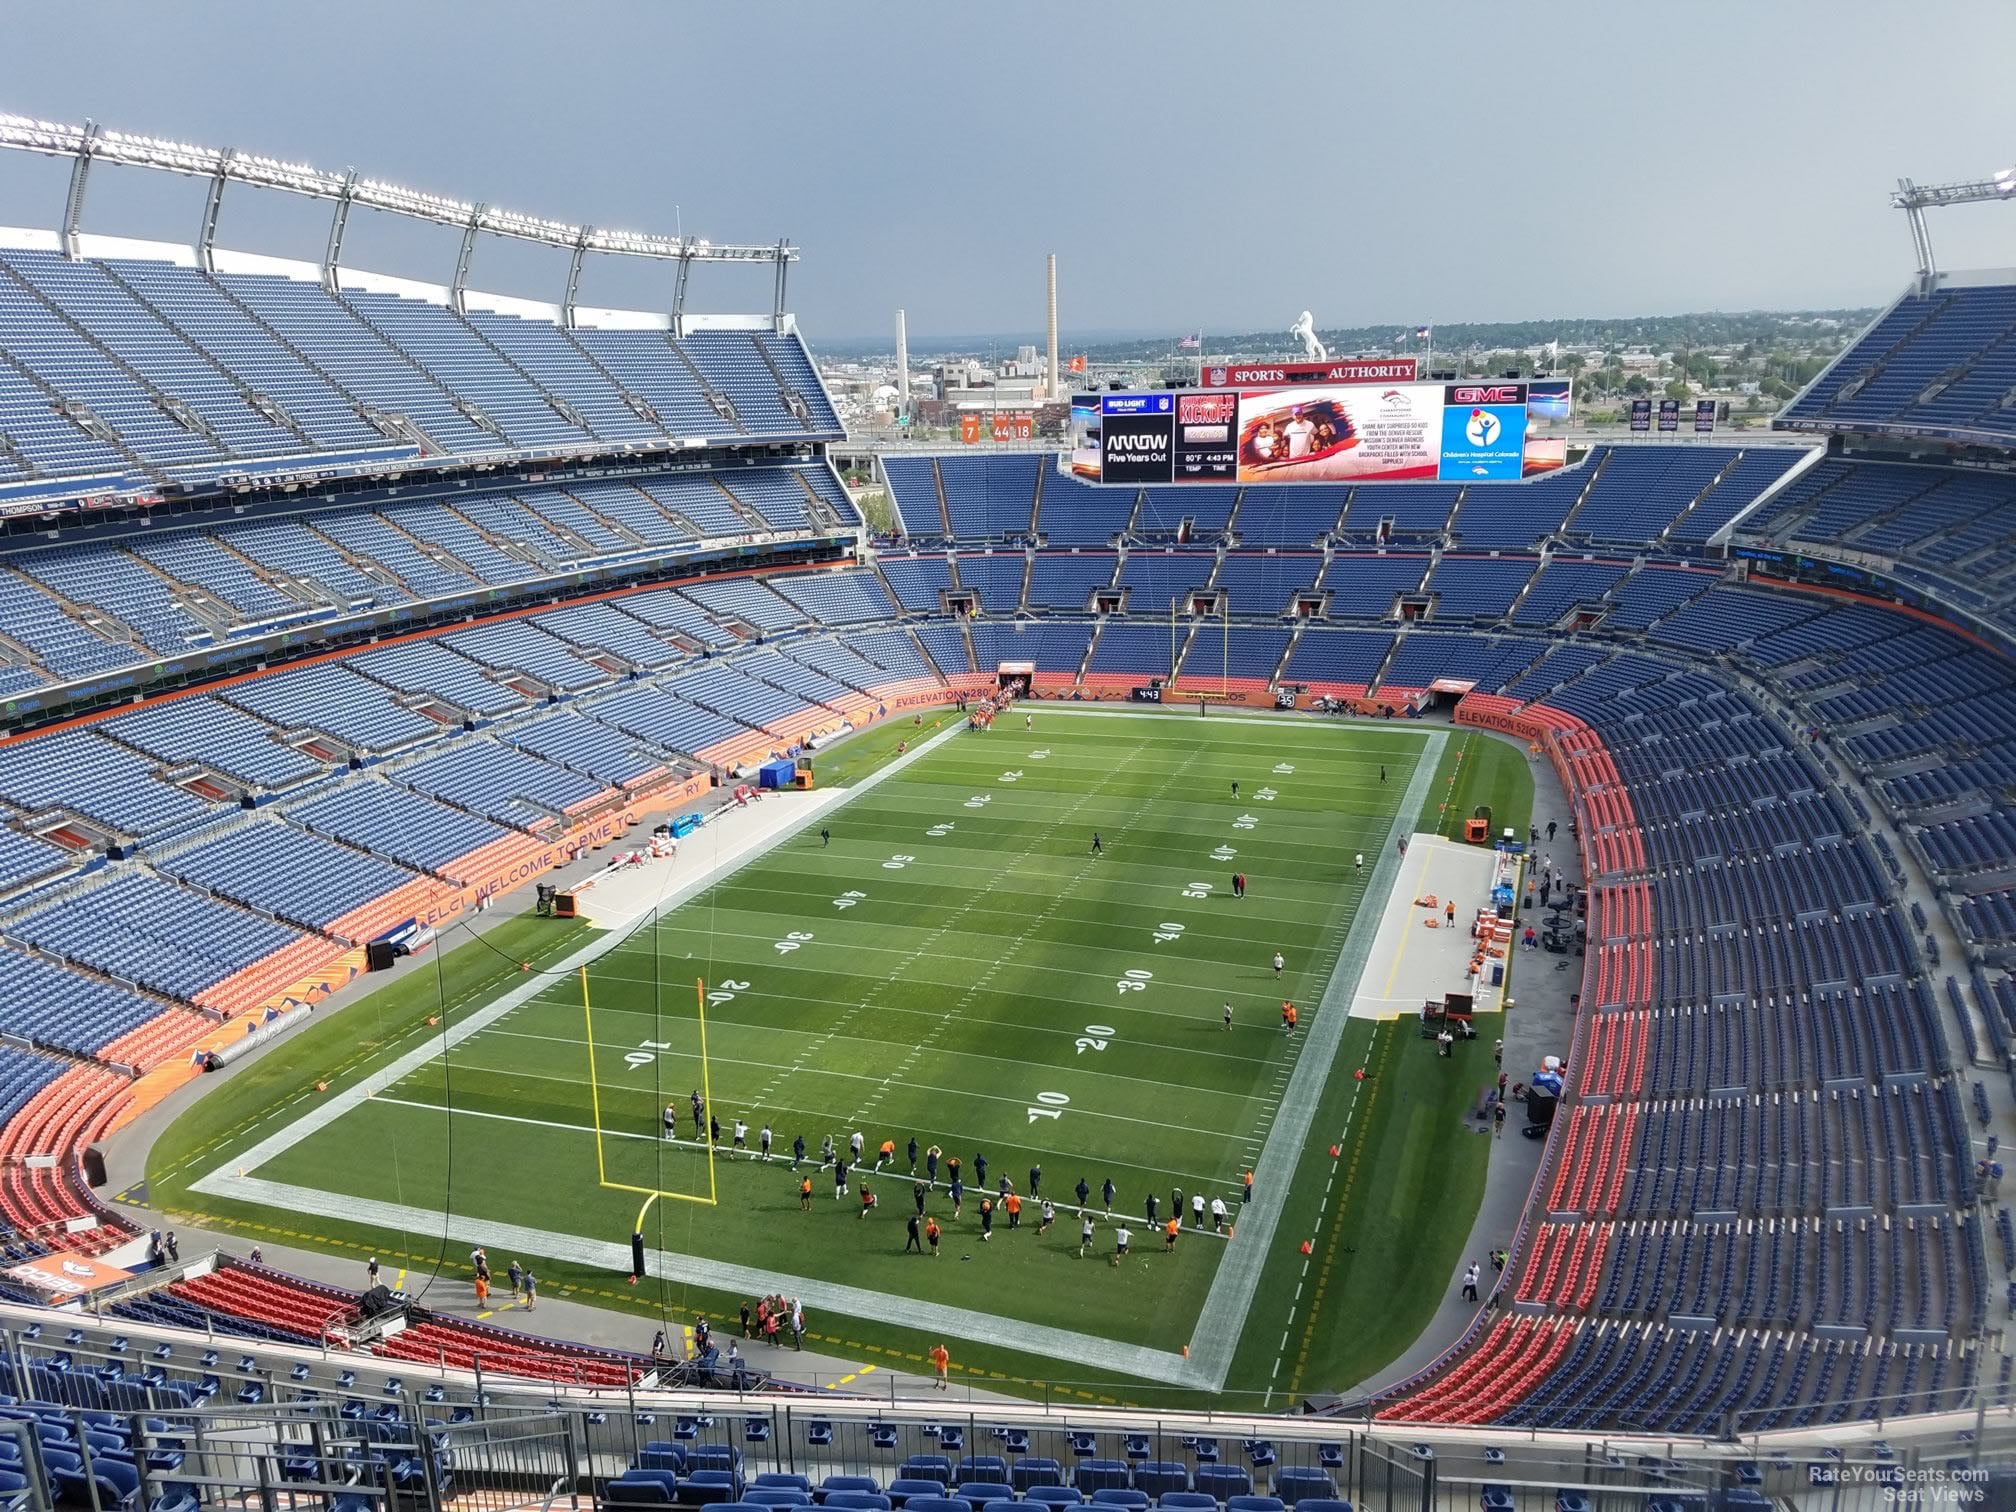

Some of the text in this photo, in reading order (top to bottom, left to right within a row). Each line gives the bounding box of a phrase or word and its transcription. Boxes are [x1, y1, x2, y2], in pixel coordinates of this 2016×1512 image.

[1235, 365, 1415, 382] SPORTS AUTHORITY
[1455, 386, 1518, 402] GMC
[1180, 404, 1234, 424] KICKOFF
[967, 427, 974, 438] 7
[995, 426, 1009, 437] 44
[1018, 426, 1030, 437] 18
[1107, 434, 1168, 450] ARROW
[1108, 452, 1166, 462] Five Years Out
[1, 503, 43, 515] THOMPSON
[1139, 690, 1159, 699] 4:43
[1459, 711, 1514, 731] ELEVATION
[1272, 763, 1295, 774] 10
[964, 794, 991, 807] 30
[1253, 788, 1278, 801] 20
[925, 824, 955, 836] 40
[1232, 817, 1259, 829] 30
[882, 854, 916, 869] 50
[1209, 847, 1238, 861] 40
[475, 850, 552, 899] WELCOME
[557, 842, 575, 861] TO
[832, 890, 867, 907] 40
[1182, 882, 1213, 899] 50
[1152, 922, 1185, 941] 40
[774, 931, 814, 950] 30
[1117, 969, 1153, 991] 30
[707, 979, 750, 1002] 20
[1075, 1024, 1116, 1051] 20
[624, 1040, 671, 1064] 10
[1027, 1091, 1070, 1120] 10
